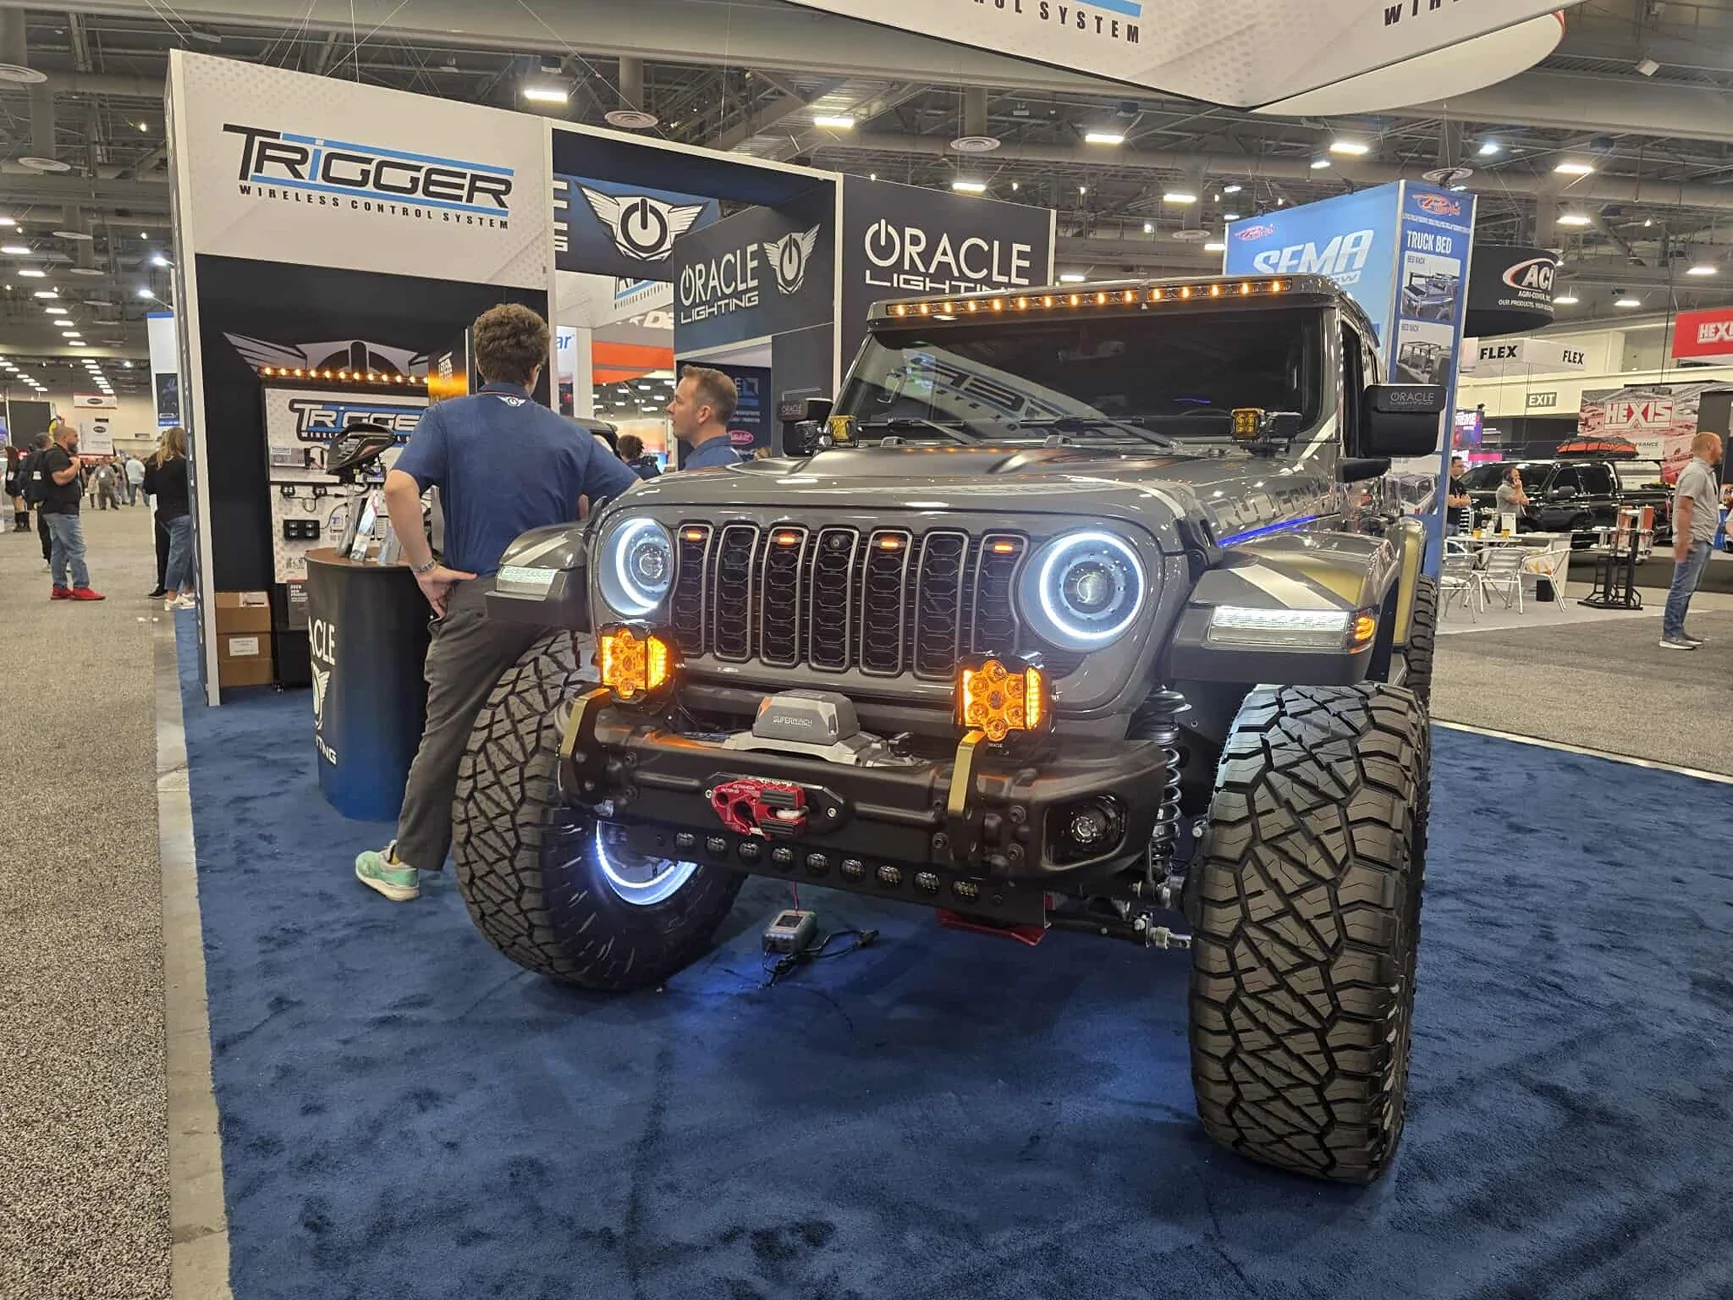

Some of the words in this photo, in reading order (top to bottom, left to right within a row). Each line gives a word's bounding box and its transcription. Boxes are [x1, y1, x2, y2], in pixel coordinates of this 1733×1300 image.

[1039, 1, 1140, 44] SYSTEM
[239, 184, 340, 207] WIRELESS
[351, 200, 433, 220] CONTROL
[442, 212, 509, 230] SYSTEM
[865, 219, 1032, 286] ORACLE
[1253, 229, 1375, 274] SEMA
[1406, 230, 1435, 252] TRUCK
[1435, 235, 1452, 255] BED
[680, 243, 759, 307] ORACLE
[865, 269, 1017, 294] LIGHTI
[1521, 264, 1555, 291] ACI
[680, 290, 759, 325] LIGHTING
[1698, 322, 1733, 344] HEXI
[1479, 345, 1519, 361] FLEX
[1562, 350, 1585, 366] FLEX
[1389, 391, 1435, 402] ORACLE
[1528, 393, 1556, 407] EXIT
[1604, 400, 1674, 430] HEXIS
